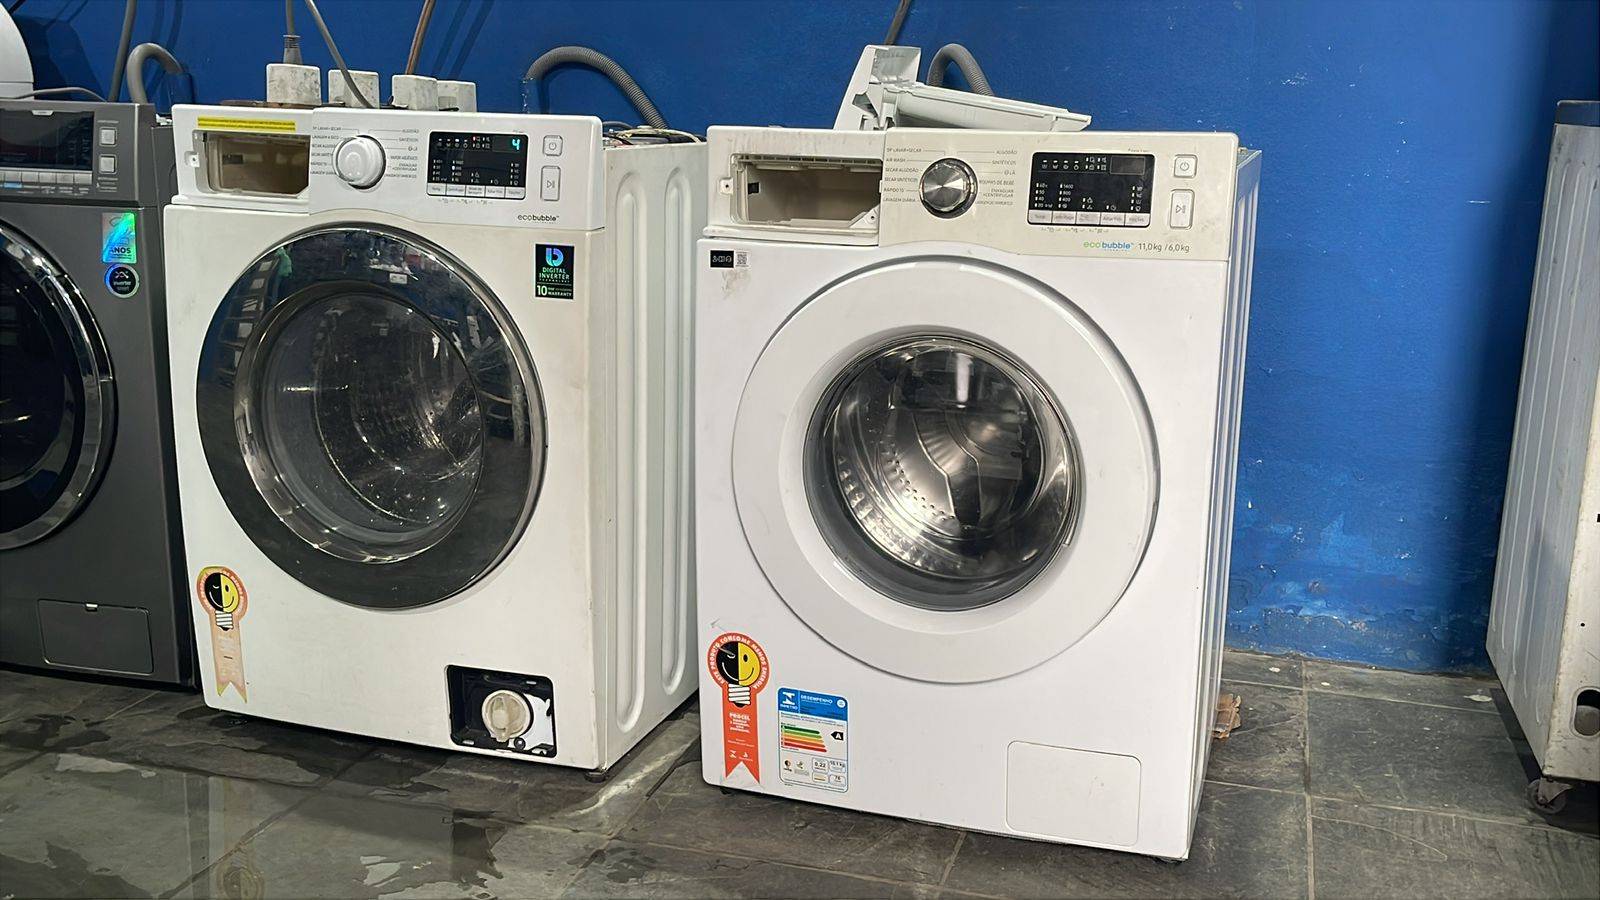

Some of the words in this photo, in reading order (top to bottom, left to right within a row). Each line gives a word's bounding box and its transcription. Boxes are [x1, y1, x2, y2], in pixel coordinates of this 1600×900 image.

[511, 138, 521, 150] 4
[537, 285, 548, 296] 10
[835, 732, 842, 740] A
